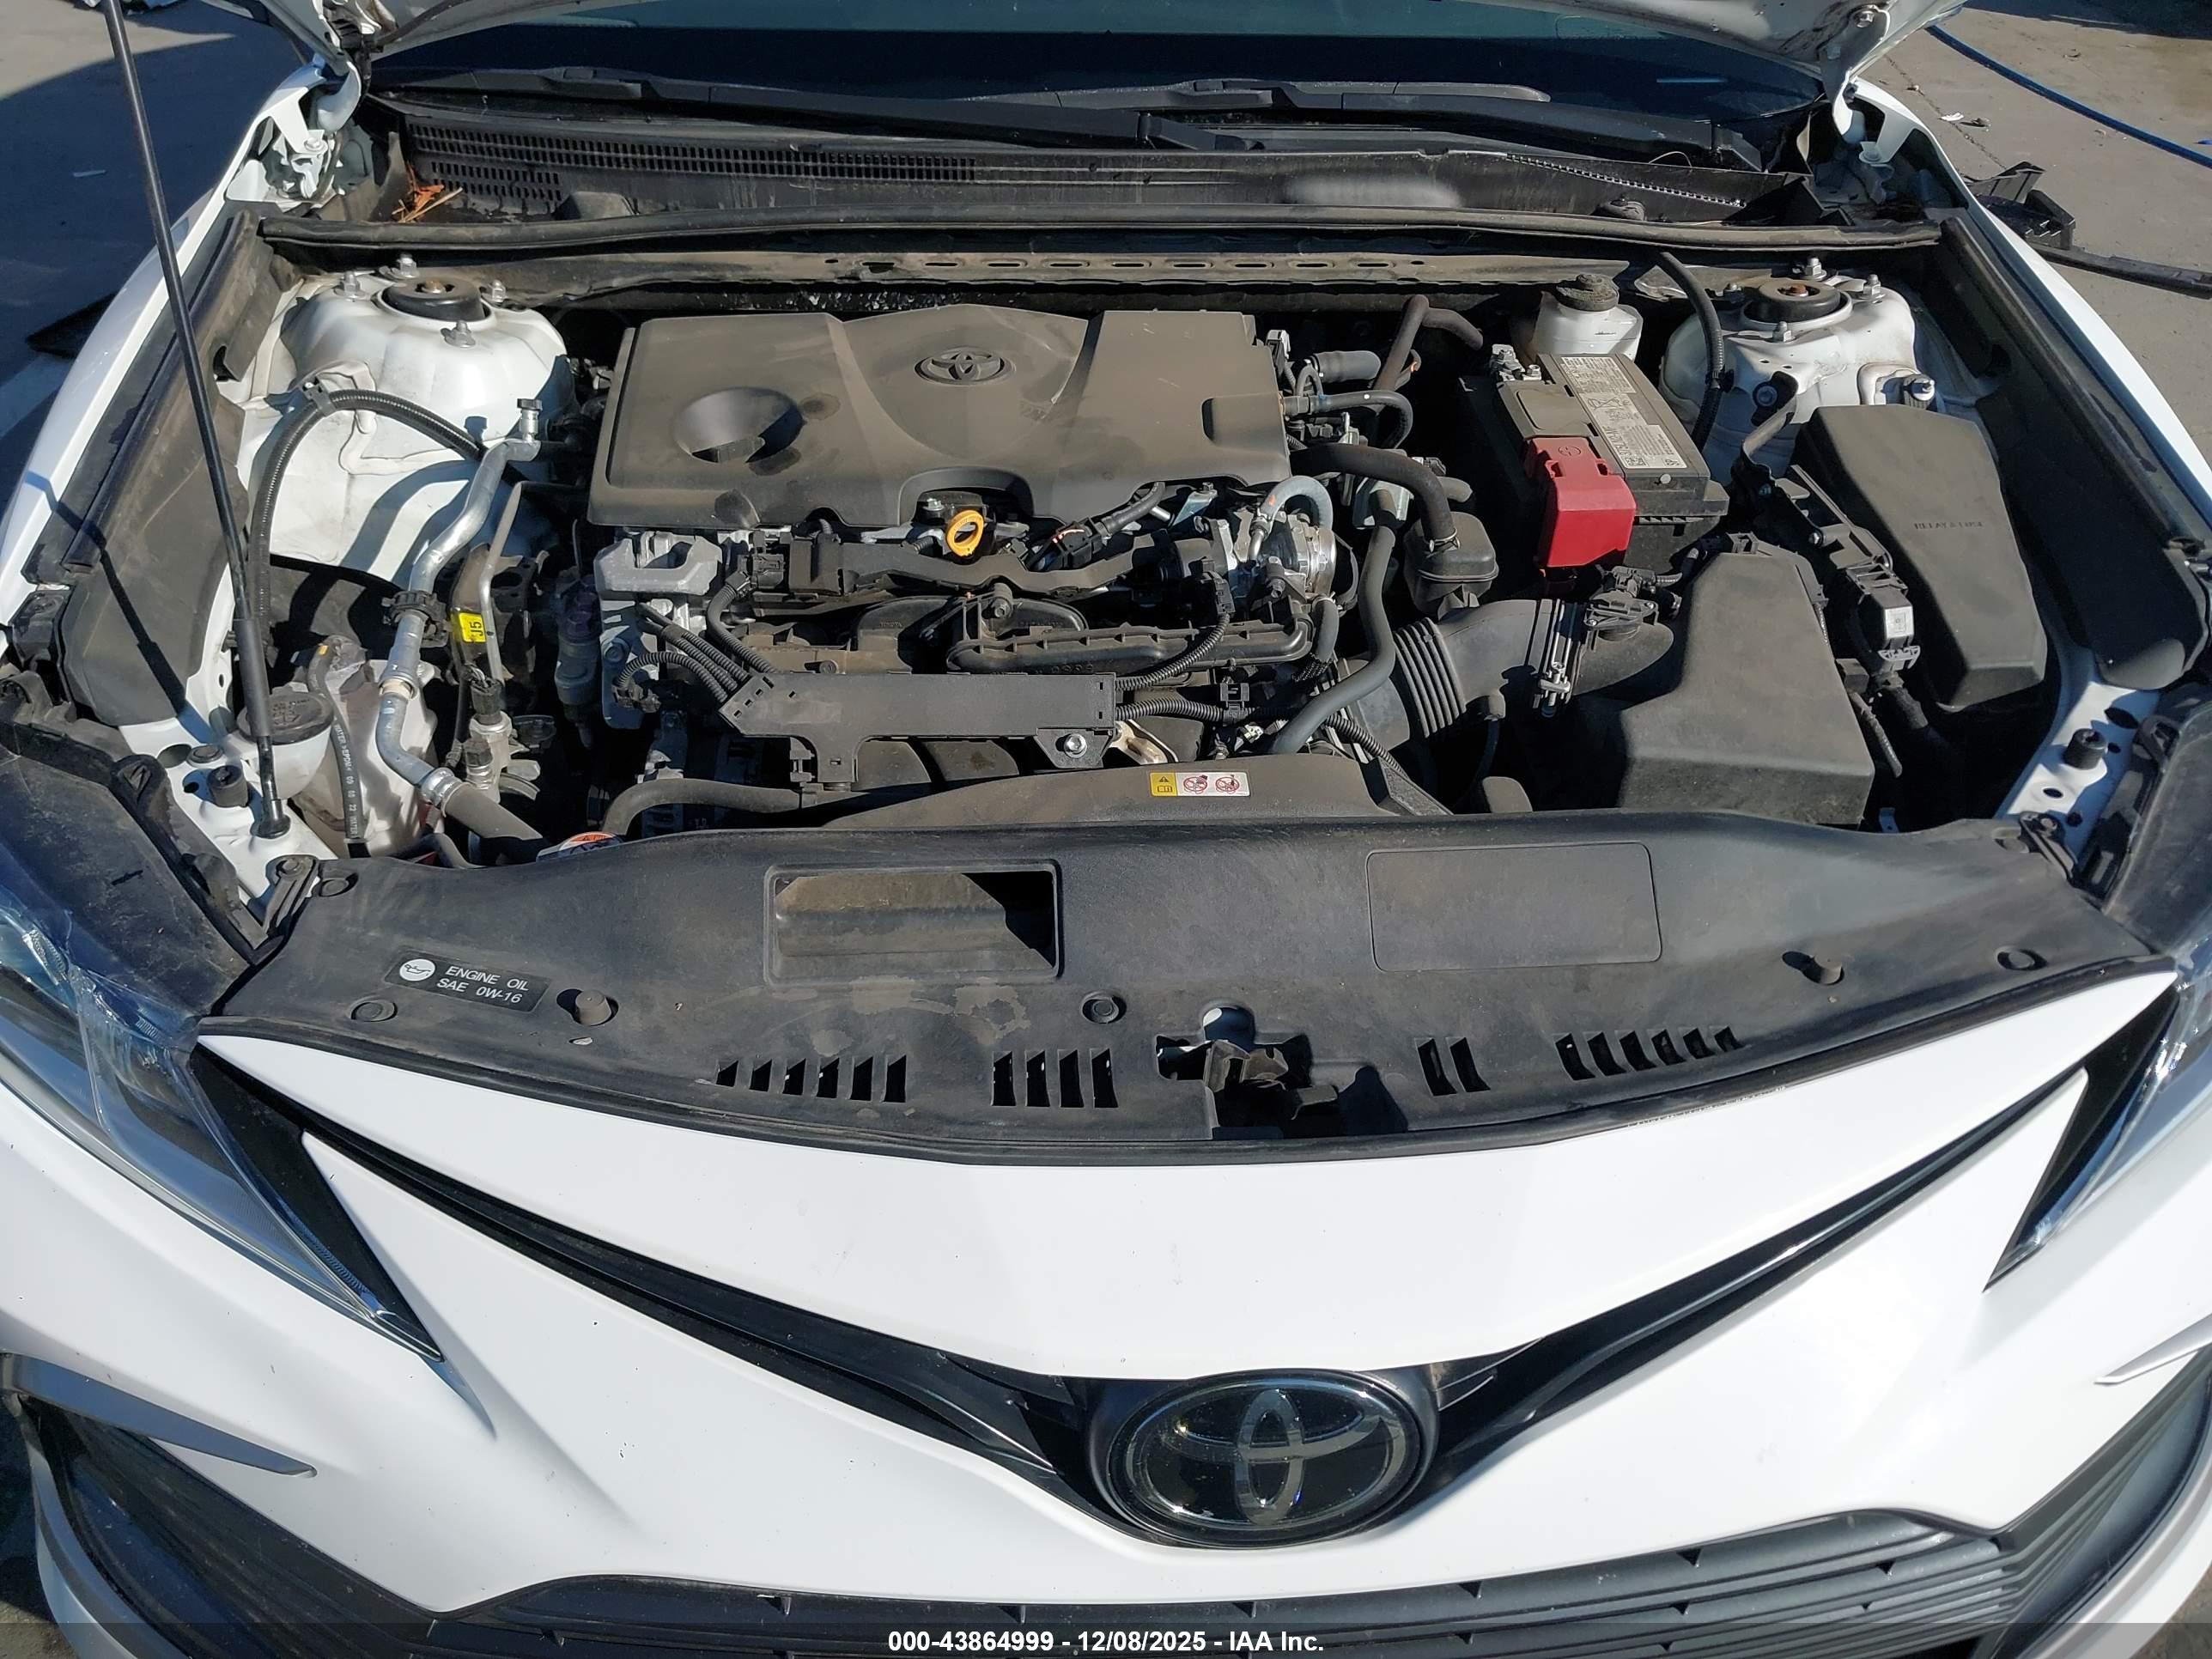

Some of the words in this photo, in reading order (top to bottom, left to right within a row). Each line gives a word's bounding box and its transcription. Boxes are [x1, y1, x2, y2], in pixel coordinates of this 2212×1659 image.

[470, 622, 483, 636] J5
[436, 977, 470, 992] SAE
[476, 987, 523, 1003] 0W-16
[445, 965, 501, 985] ENGINE
[507, 979, 529, 991] OIL
